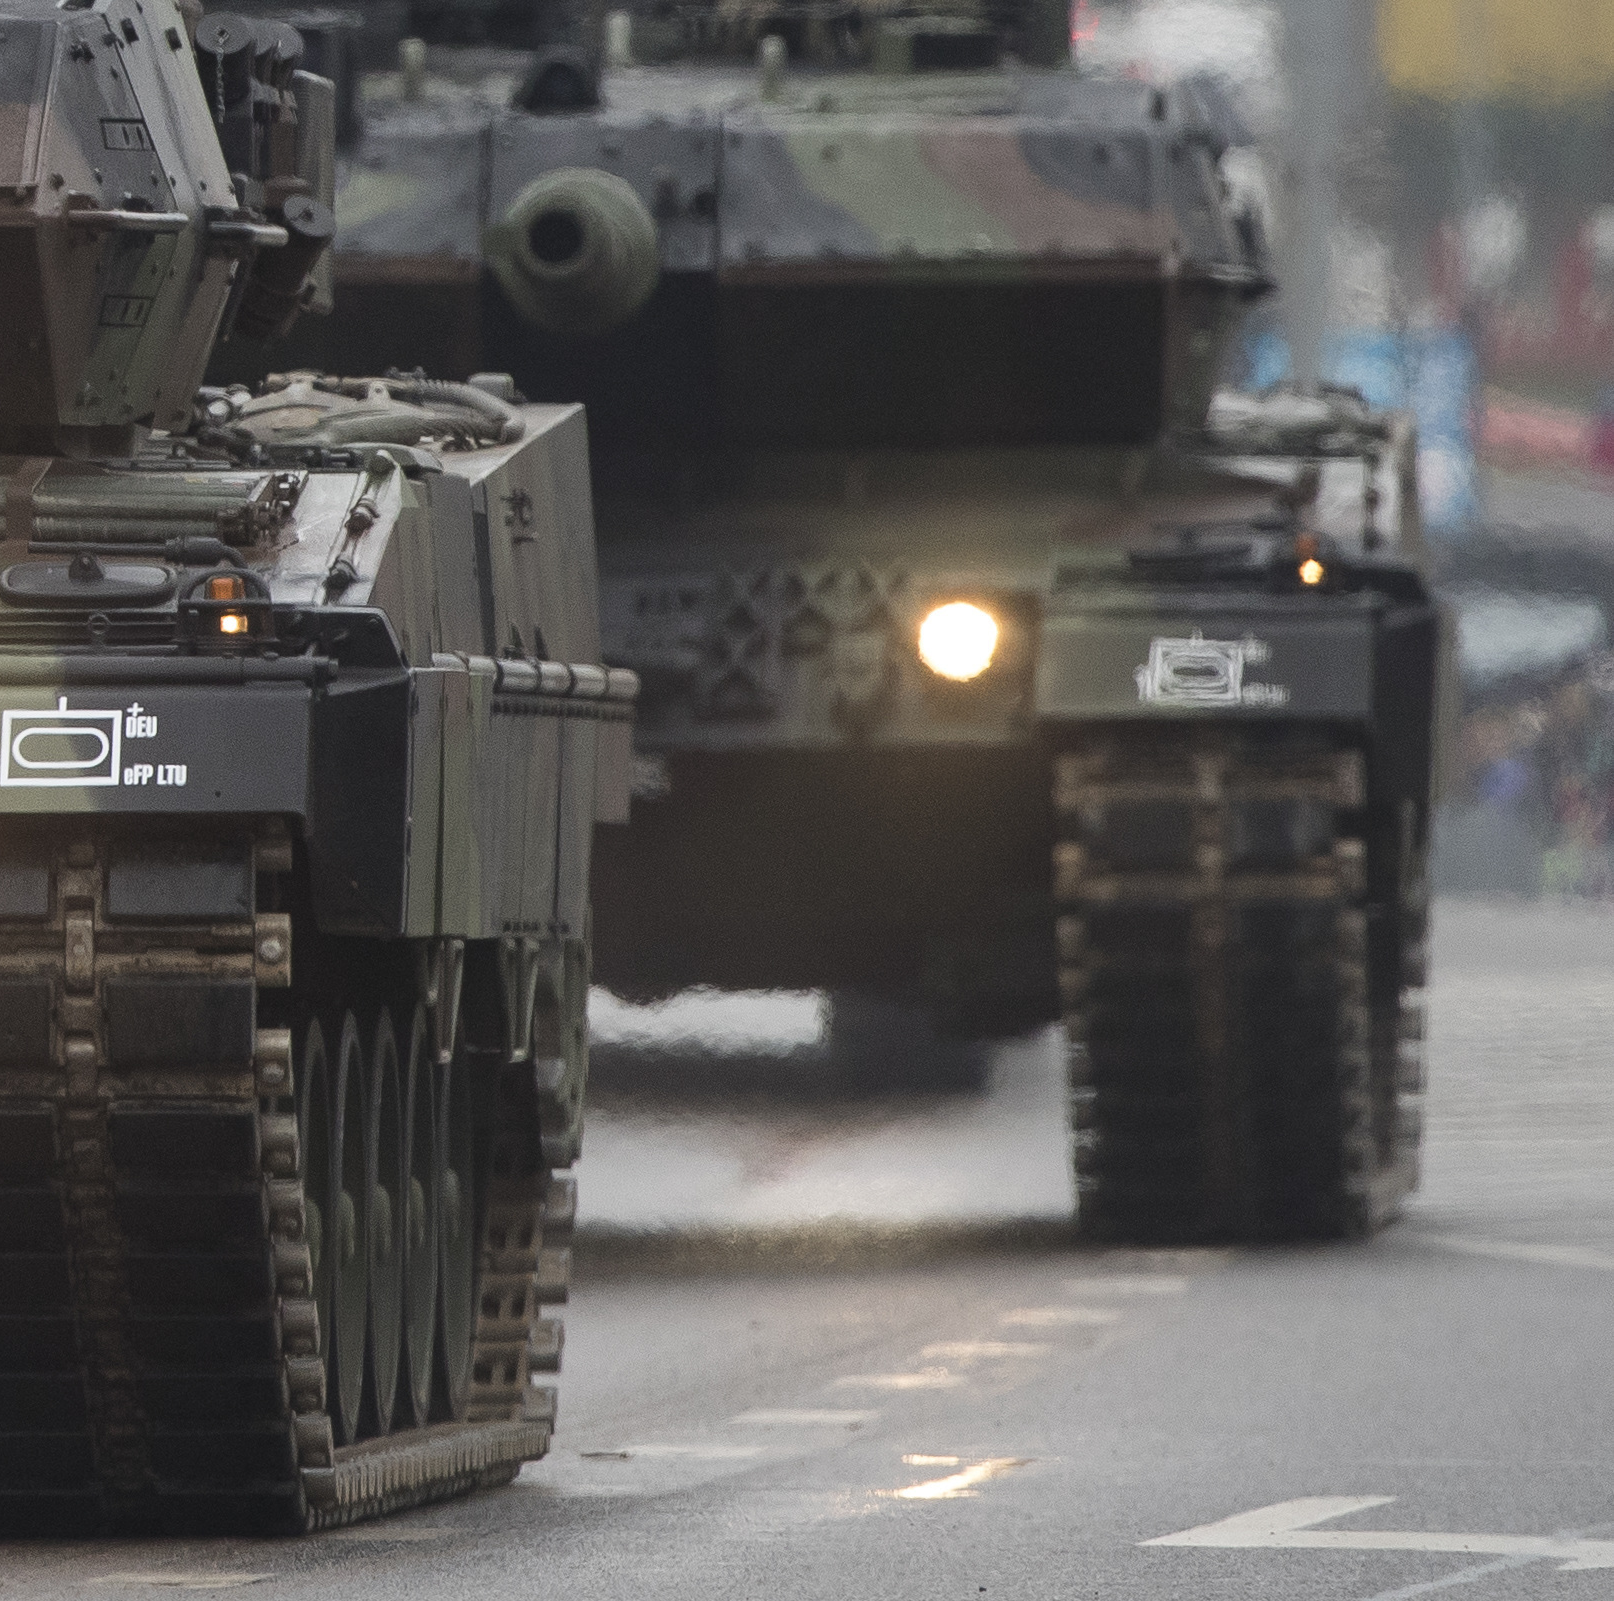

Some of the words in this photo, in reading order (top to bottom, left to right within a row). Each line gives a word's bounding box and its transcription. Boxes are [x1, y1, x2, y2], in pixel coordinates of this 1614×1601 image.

[125, 715, 158, 738] DEU
[123, 764, 154, 786] eFP
[157, 764, 188, 786] LTU
